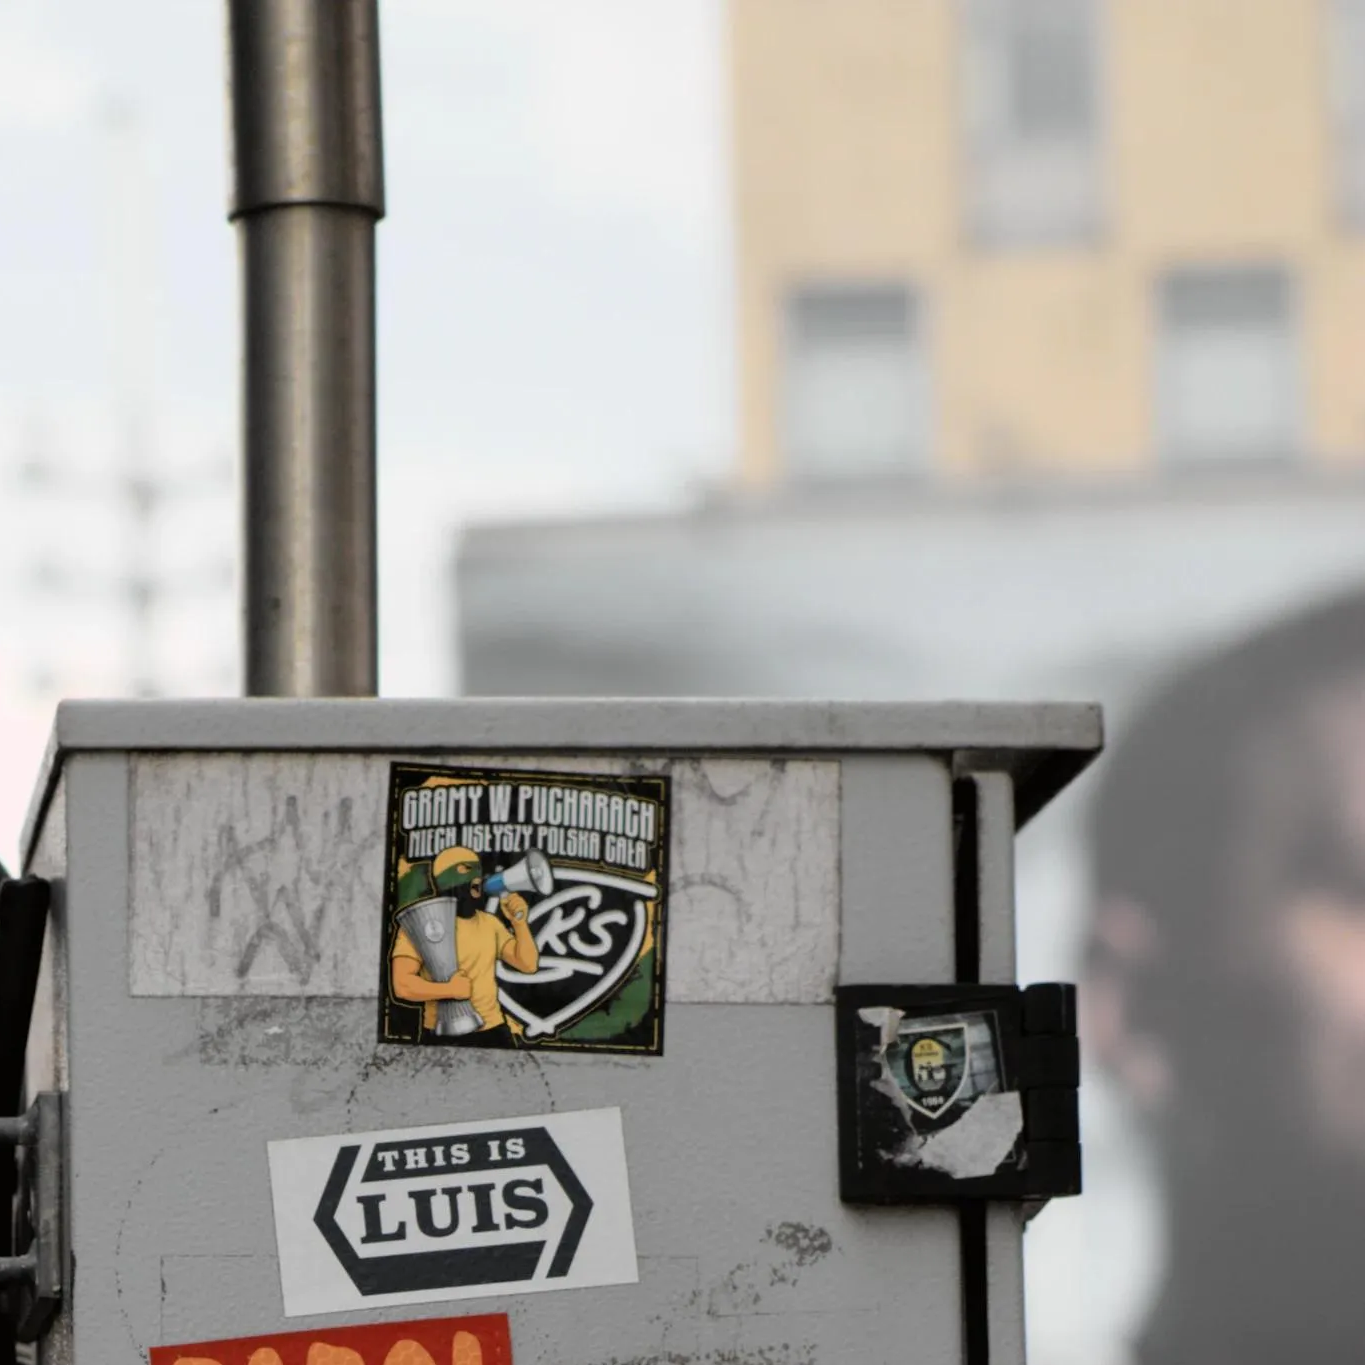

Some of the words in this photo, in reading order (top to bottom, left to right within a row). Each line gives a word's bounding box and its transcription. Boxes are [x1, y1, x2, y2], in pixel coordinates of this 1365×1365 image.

[402, 785, 483, 829] GRAMY
[489, 785, 512, 823] W
[518, 785, 655, 841] PUCHARACH
[538, 826, 600, 860] POLSKA
[378, 1144, 470, 1171] THIS
[488, 1138, 526, 1161] IS
[356, 1178, 548, 1244] LUIS
